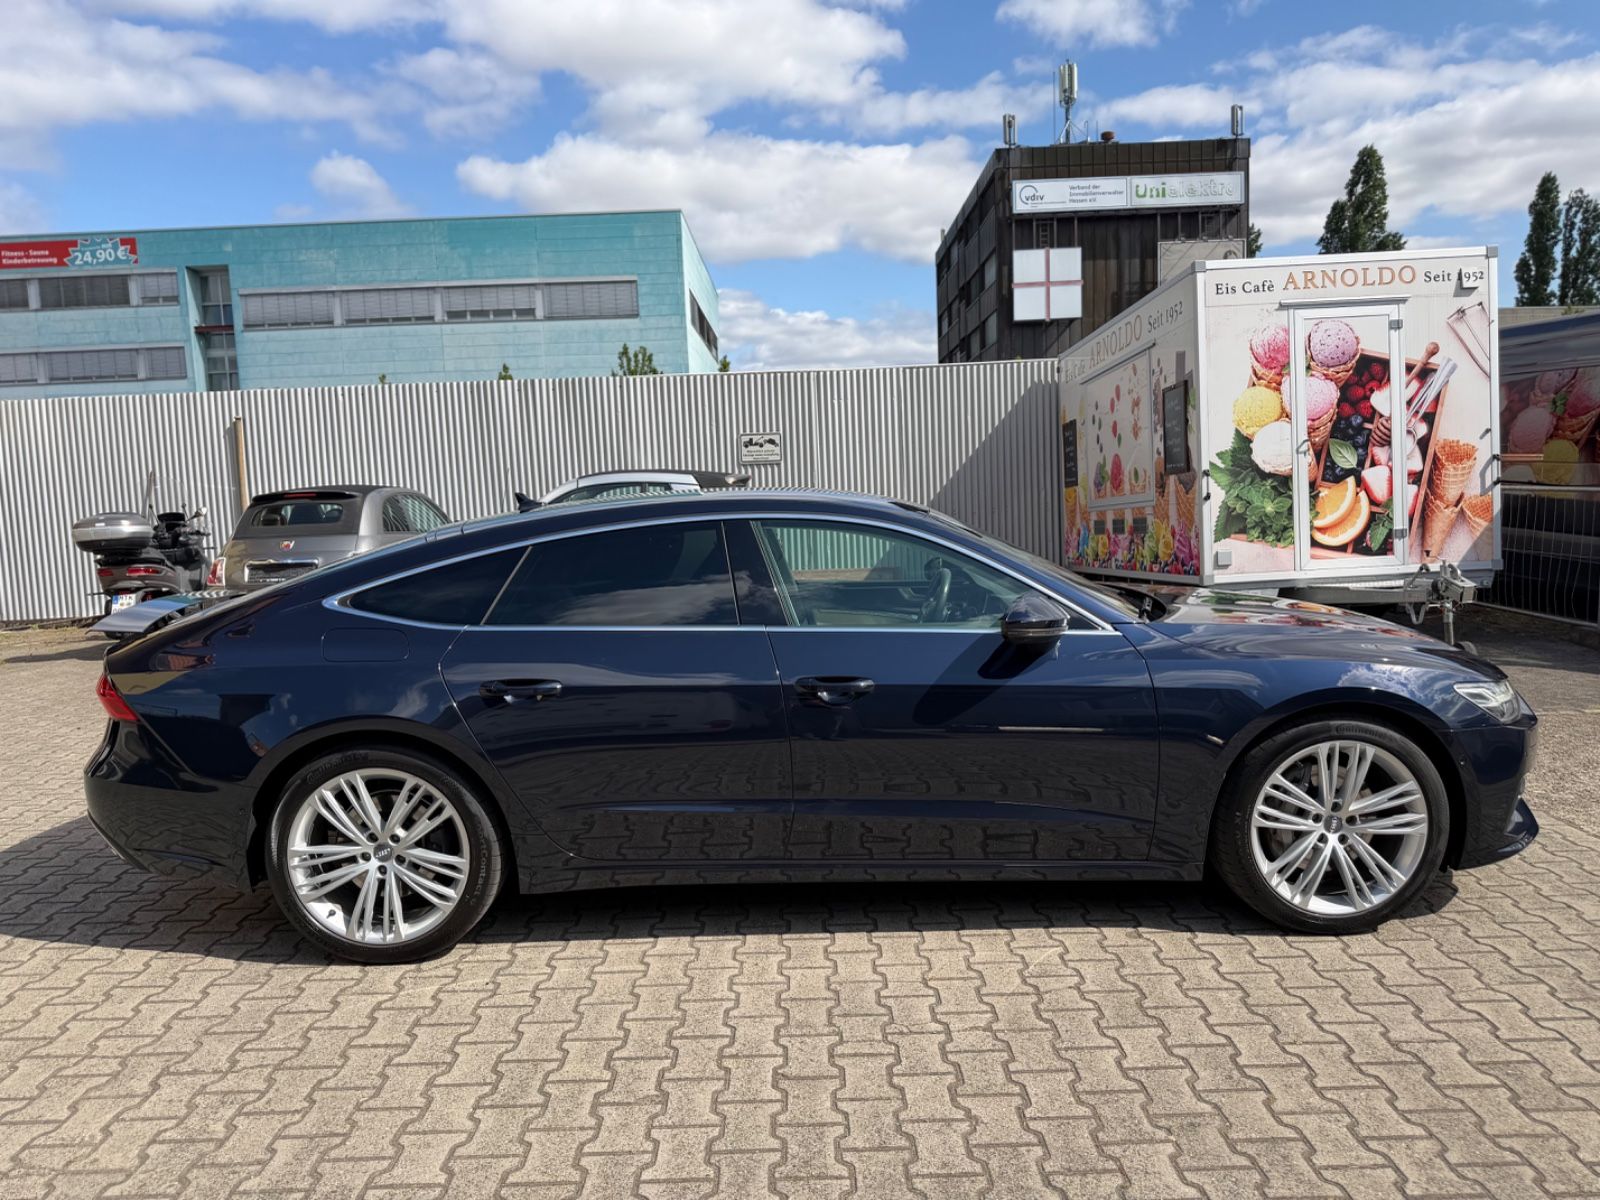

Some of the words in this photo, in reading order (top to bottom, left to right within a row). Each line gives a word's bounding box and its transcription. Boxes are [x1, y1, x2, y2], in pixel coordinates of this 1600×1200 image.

[1215, 283, 1236, 295] Eis
[1283, 265, 1416, 290] ARNOLDO
[1424, 270, 1452, 283] Seit
[1089, 314, 1142, 369] ARNOLDO
[1147, 310, 1163, 333] Seit
[1165, 300, 1183, 323] 1952
